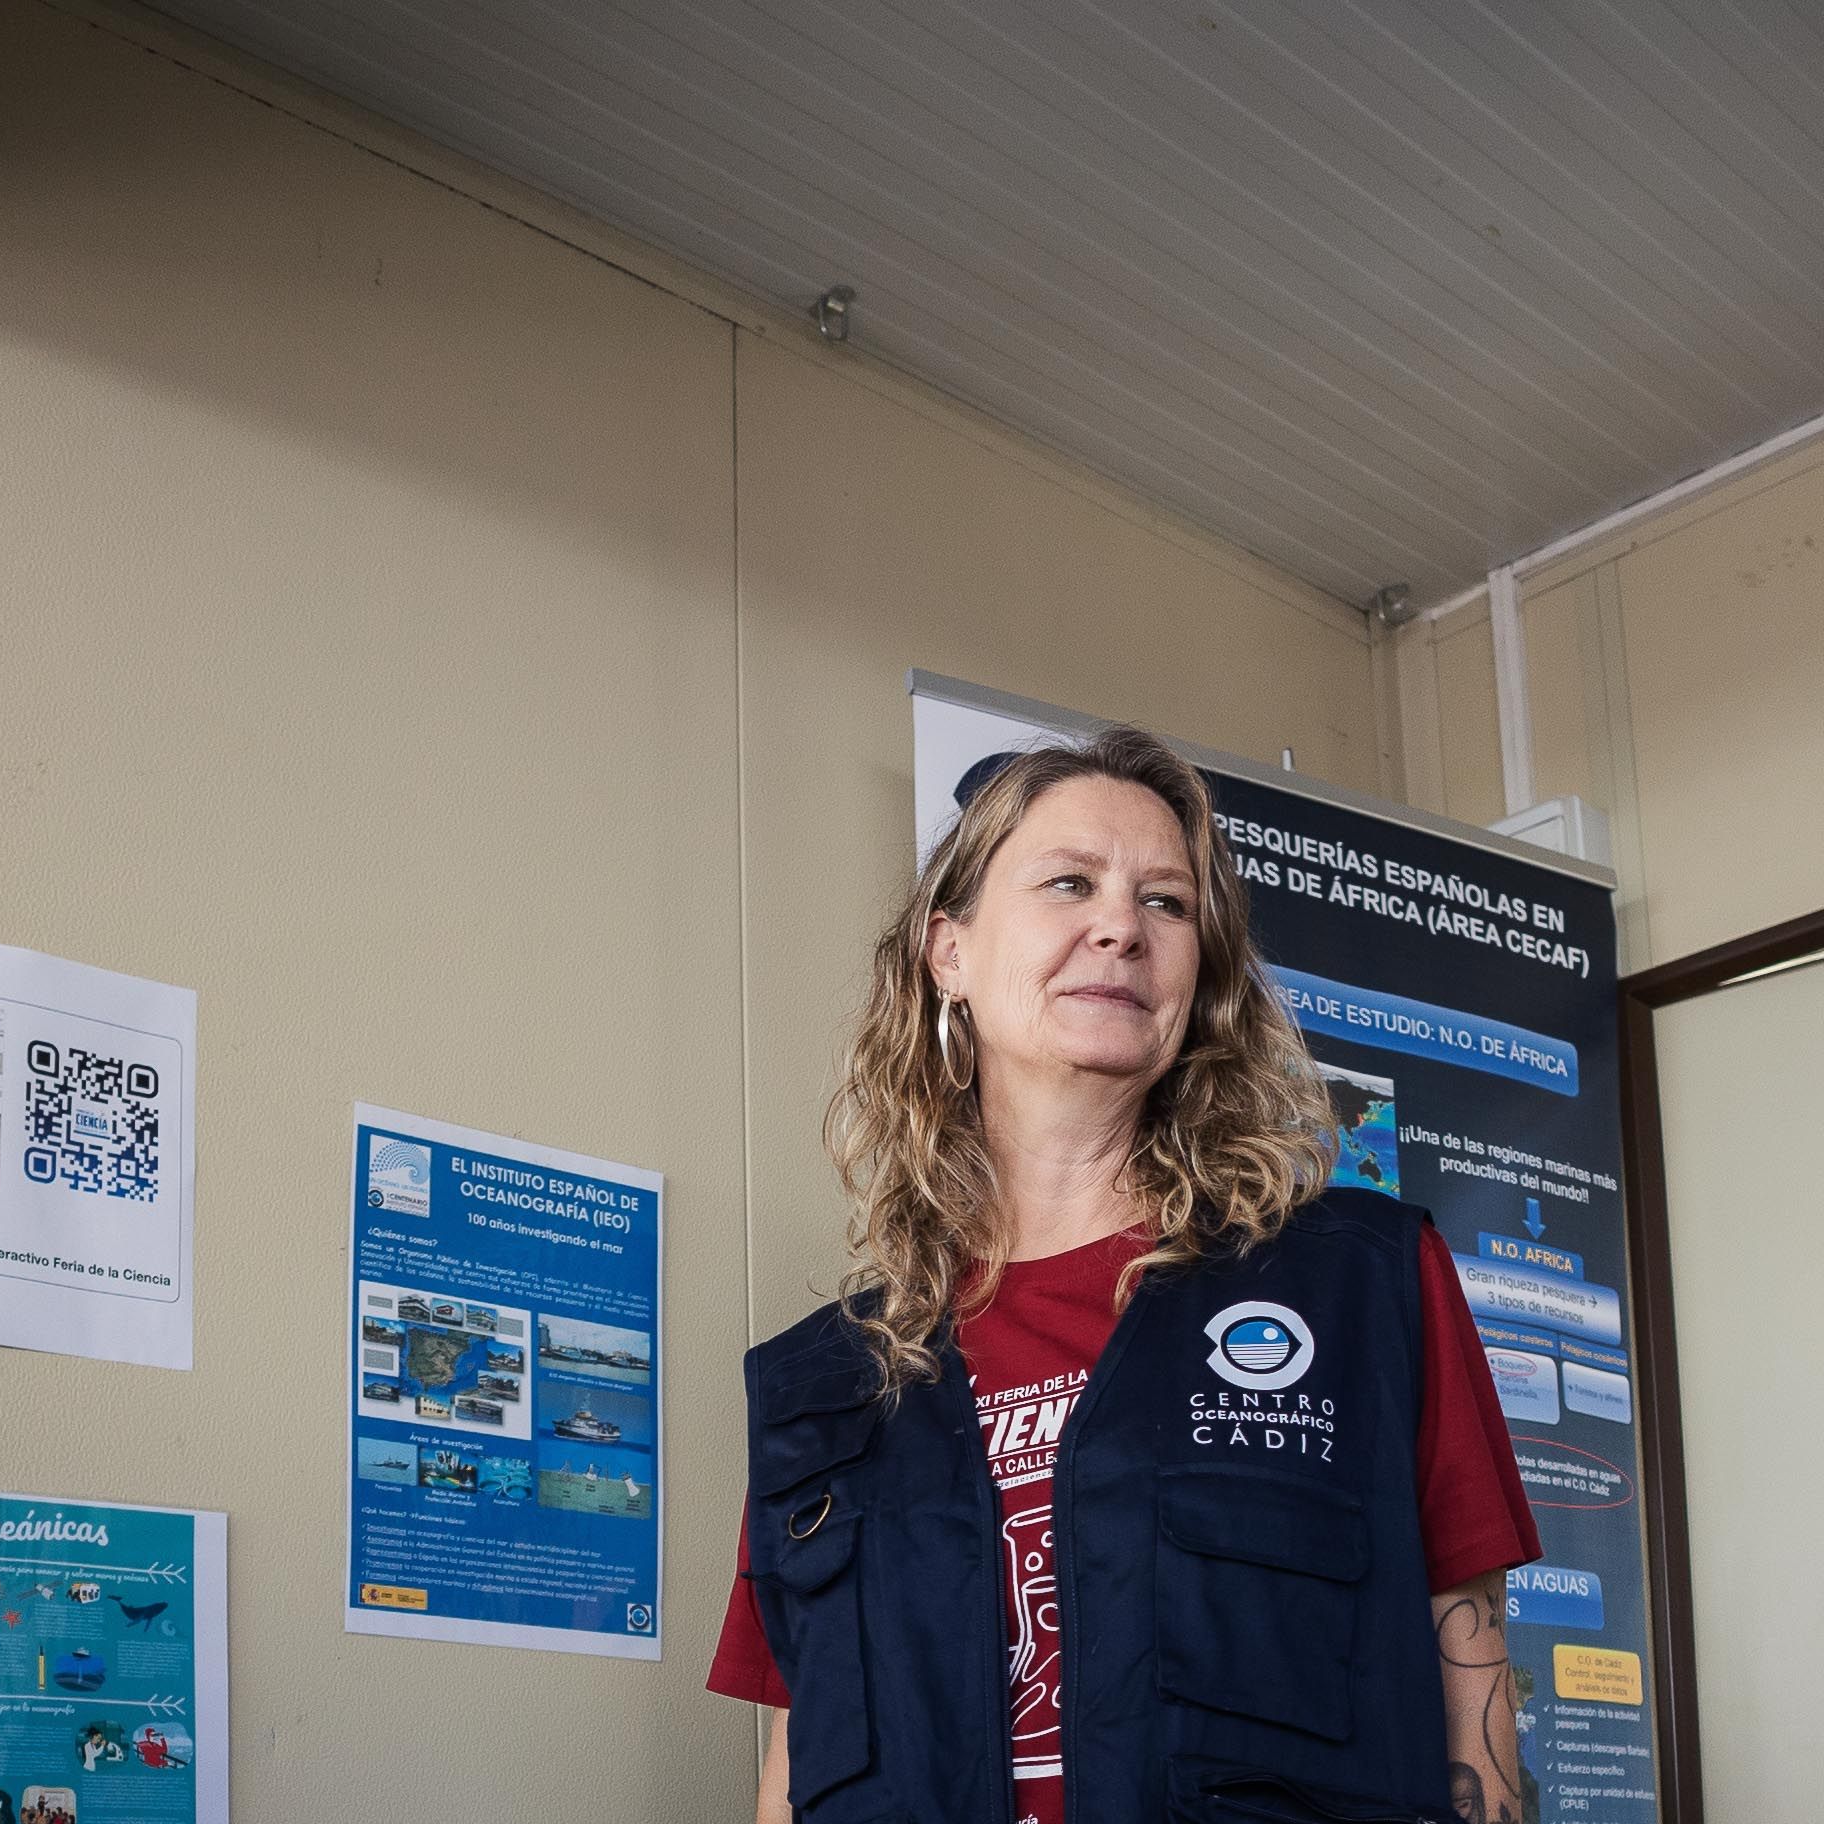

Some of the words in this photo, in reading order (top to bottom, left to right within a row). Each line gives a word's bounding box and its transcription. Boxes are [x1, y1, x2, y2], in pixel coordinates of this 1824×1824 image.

[1212, 812, 1378, 878] PESQUERÍAS
[1384, 861, 1527, 922] ESPAÑOLAS
[1533, 904, 1564, 933] EN
[1288, 867, 1323, 899] DE
[1329, 876, 1423, 926] ÁFRICA
[1427, 904, 1502, 948] (ÁREA
[1506, 929, 1589, 979] CECAF)
[1317, 996, 1342, 1020] DE
[1347, 1005, 1435, 1040] ESTUDIO:
[1439, 1026, 1476, 1051] N.O.
[1481, 1036, 1505, 1060] DE
[1510, 1042, 1568, 1078] ÁFRICA
[1444, 1132, 1461, 1150] de
[1464, 1136, 1485, 1156] las
[1488, 1141, 1543, 1170] regiones
[1545, 1158, 1591, 1182] marinas
[1593, 1172, 1618, 1192] más
[451, 1156, 468, 1173] EL
[472, 1160, 546, 1190] INSTITUTO
[549, 1178, 618, 1209] ESPAÑOL
[620, 1194, 639, 1212] DE
[1439, 1156, 1518, 1186] productivas
[1521, 1172, 1540, 1190] del
[1542, 1177, 1590, 1204] mundo!!
[460, 1181, 590, 1222] OCEANOGRAFÍA
[593, 1208, 631, 1234] (IEO)
[367, 1226, 406, 1243] ¿Quiénes
[409, 1235, 438, 1249] somos?
[467, 1211, 487, 1227] 100
[489, 1216, 516, 1234] años
[518, 1223, 587, 1249] investigando
[590, 1235, 600, 1249] el
[603, 1242, 624, 1255] mar
[1491, 1239, 1523, 1261] N.O.
[1525, 1246, 1574, 1273] AFRICA
[53, 1257, 85, 1273] Feria
[88, 1263, 105, 1277] de
[108, 1267, 119, 1279] la
[122, 1268, 171, 1287] Ciencia
[1466, 1267, 1495, 1285] Gran
[1498, 1273, 1539, 1295] riqueza
[1542, 1283, 1586, 1307] pesquera
[1487, 1291, 1495, 1305] 3
[1498, 1294, 1526, 1312] tipos
[1528, 1299, 1542, 1315] de
[1544, 1306, 1584, 1325] recursos
[994, 1383, 1040, 1405] FERIA
[1043, 1375, 1065, 1393] DE
[1068, 1369, 1089, 1386] LA
[1190, 1392, 1334, 1416] CENTRO
[1191, 1409, 1334, 1433] OCEANOGRÁFICO
[410, 1431, 429, 1443] Áreas
[431, 1435, 440, 1446] de
[442, 1437, 484, 1451] investigación
[1192, 1422, 1333, 1462] CÁDIZ
[1005, 1451, 1055, 1474] CALLE
[1537, 1457, 1587, 1477] desarrolladas
[1589, 1468, 1599, 1478] en
[1552, 1476, 1563, 1486] en
[1532, 1573, 1589, 1597] AGUAS
[1555, 1704, 1596, 1718] Información
[1598, 1707, 1606, 1718] de
[1607, 1708, 1613, 1719] la
[1555, 1720, 1590, 1731] pesquera
[1557, 1740, 1591, 1755] Capturas
[1558, 1762, 1591, 1774] Esfuerzo
[1592, 1765, 1624, 1777] específico
[1559, 1785, 1589, 1798] Captura
[1590, 1789, 1602, 1798] por
[1560, 1799, 1589, 1811] (CPUE)
